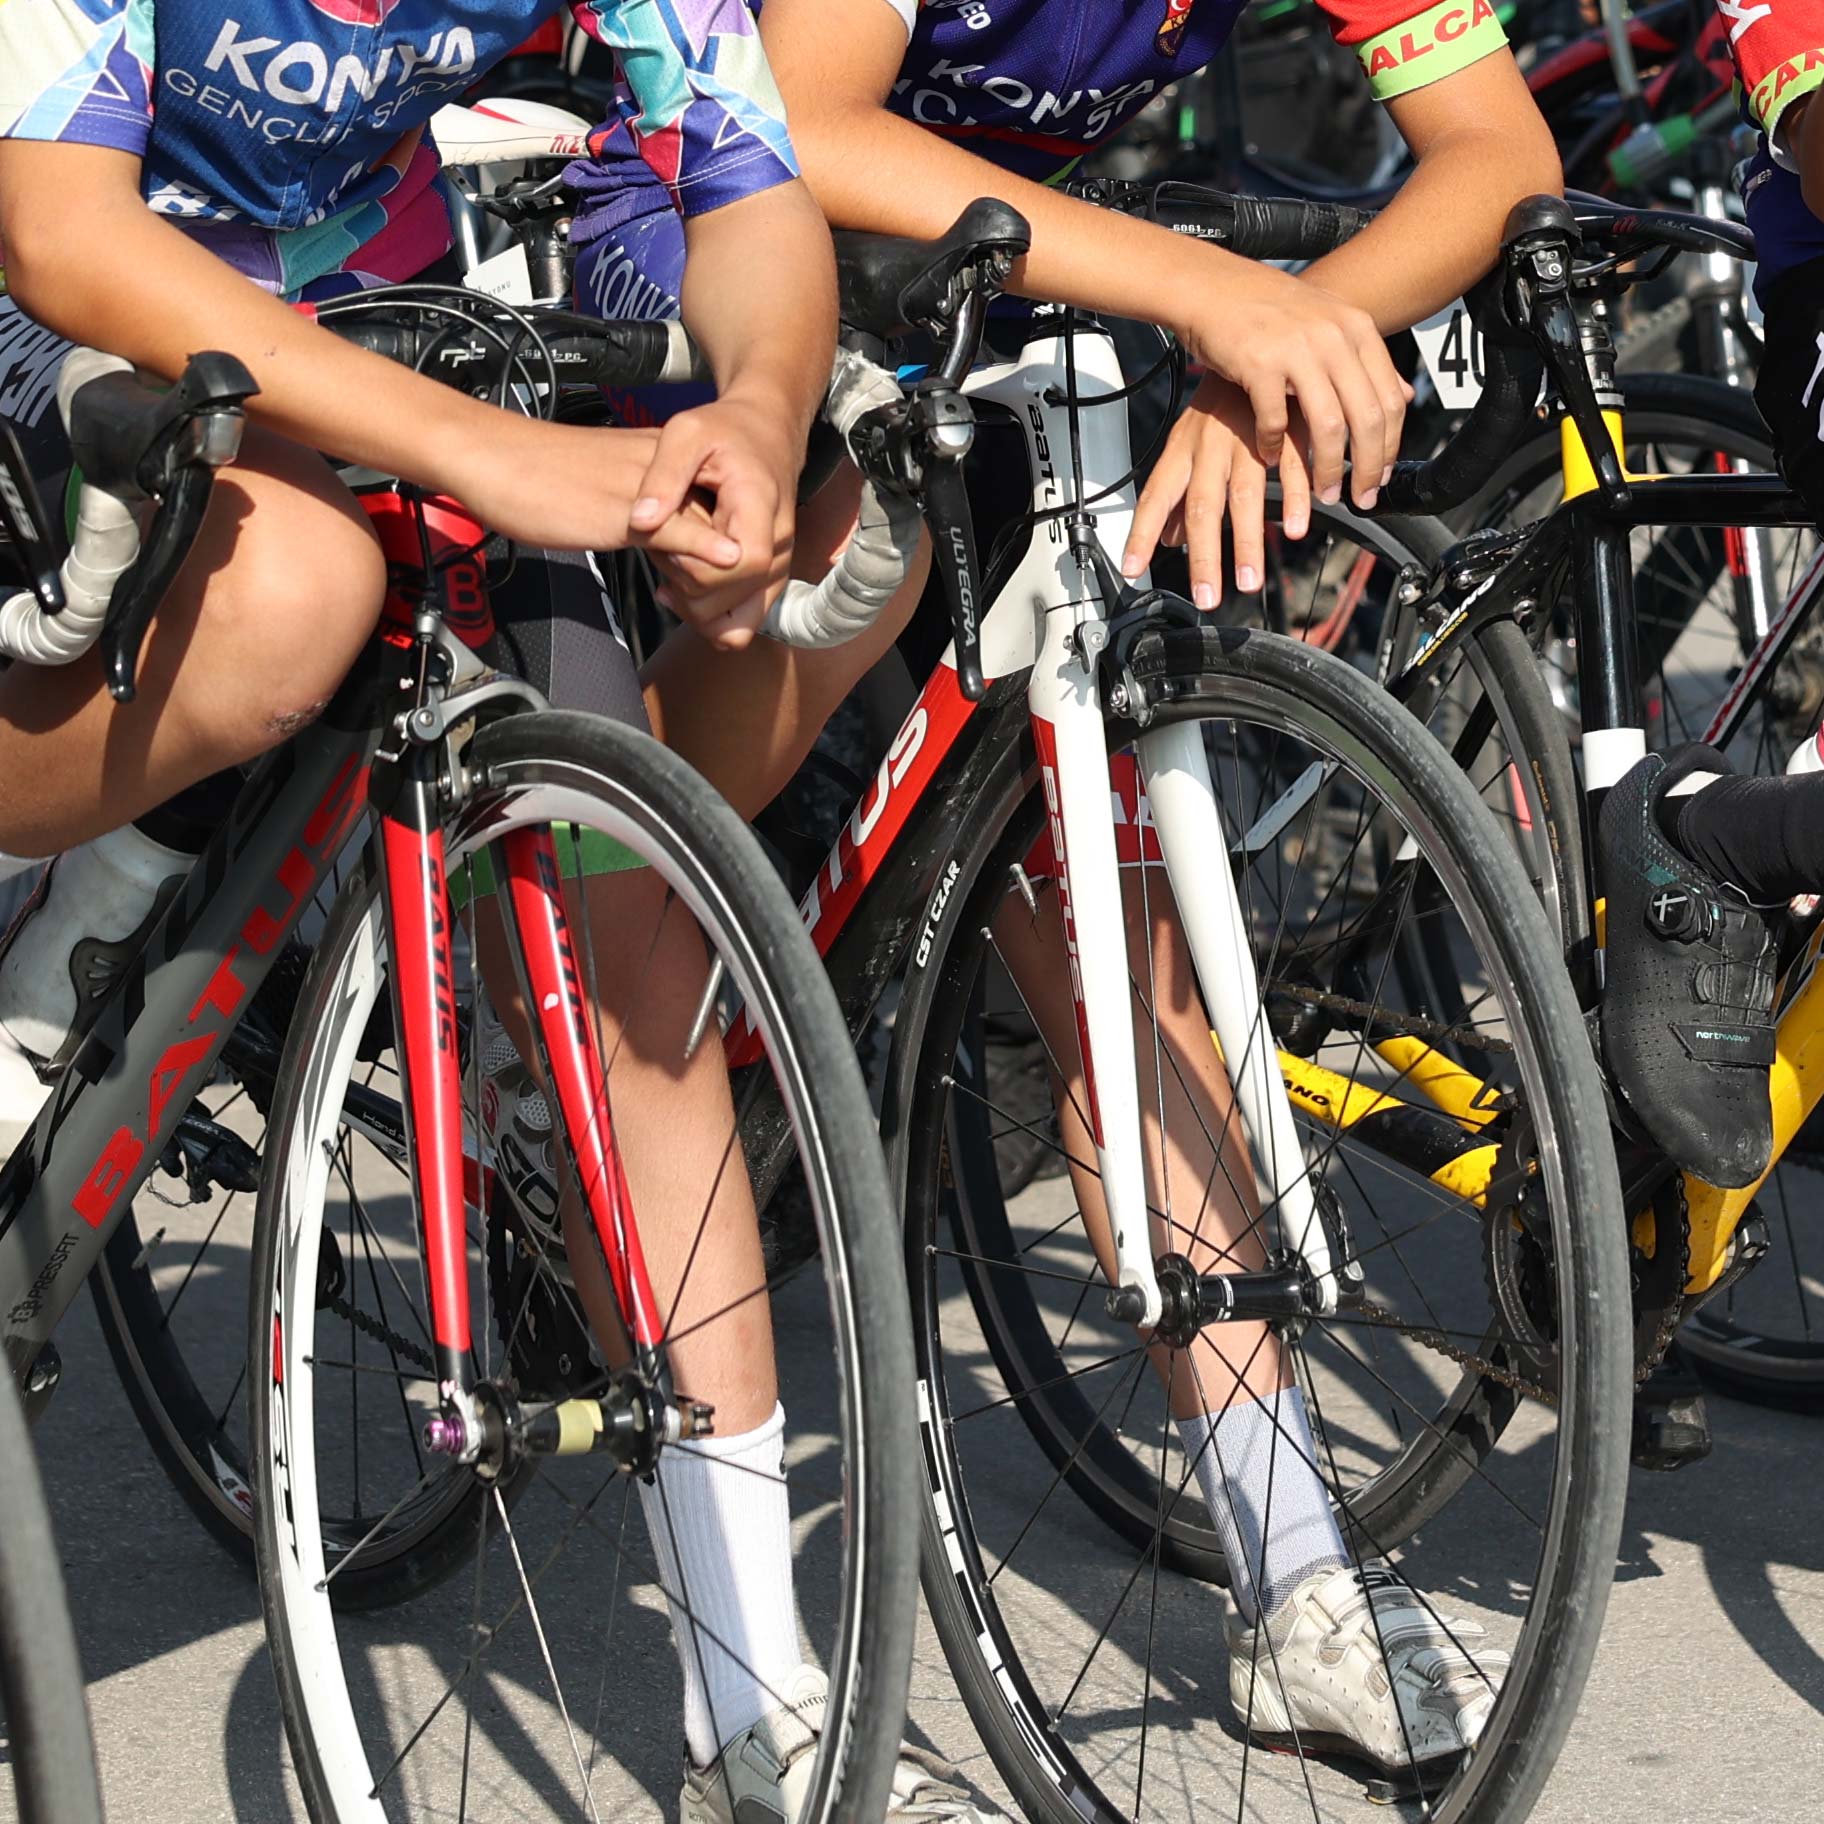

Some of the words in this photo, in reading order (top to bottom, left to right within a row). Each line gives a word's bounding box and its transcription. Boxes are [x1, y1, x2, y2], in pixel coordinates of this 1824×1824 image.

[203, 17, 477, 113] KONYA
[949, 526, 978, 649] ULTEGRA
[418, 852, 456, 1057] BATUS
[914, 919, 942, 970] CST
[928, 858, 964, 921] CZAR
[71, 750, 376, 1231] BATUS
[1695, 1030, 1751, 1043] northwave
[29, 1232, 81, 1309] PRESSFIT
